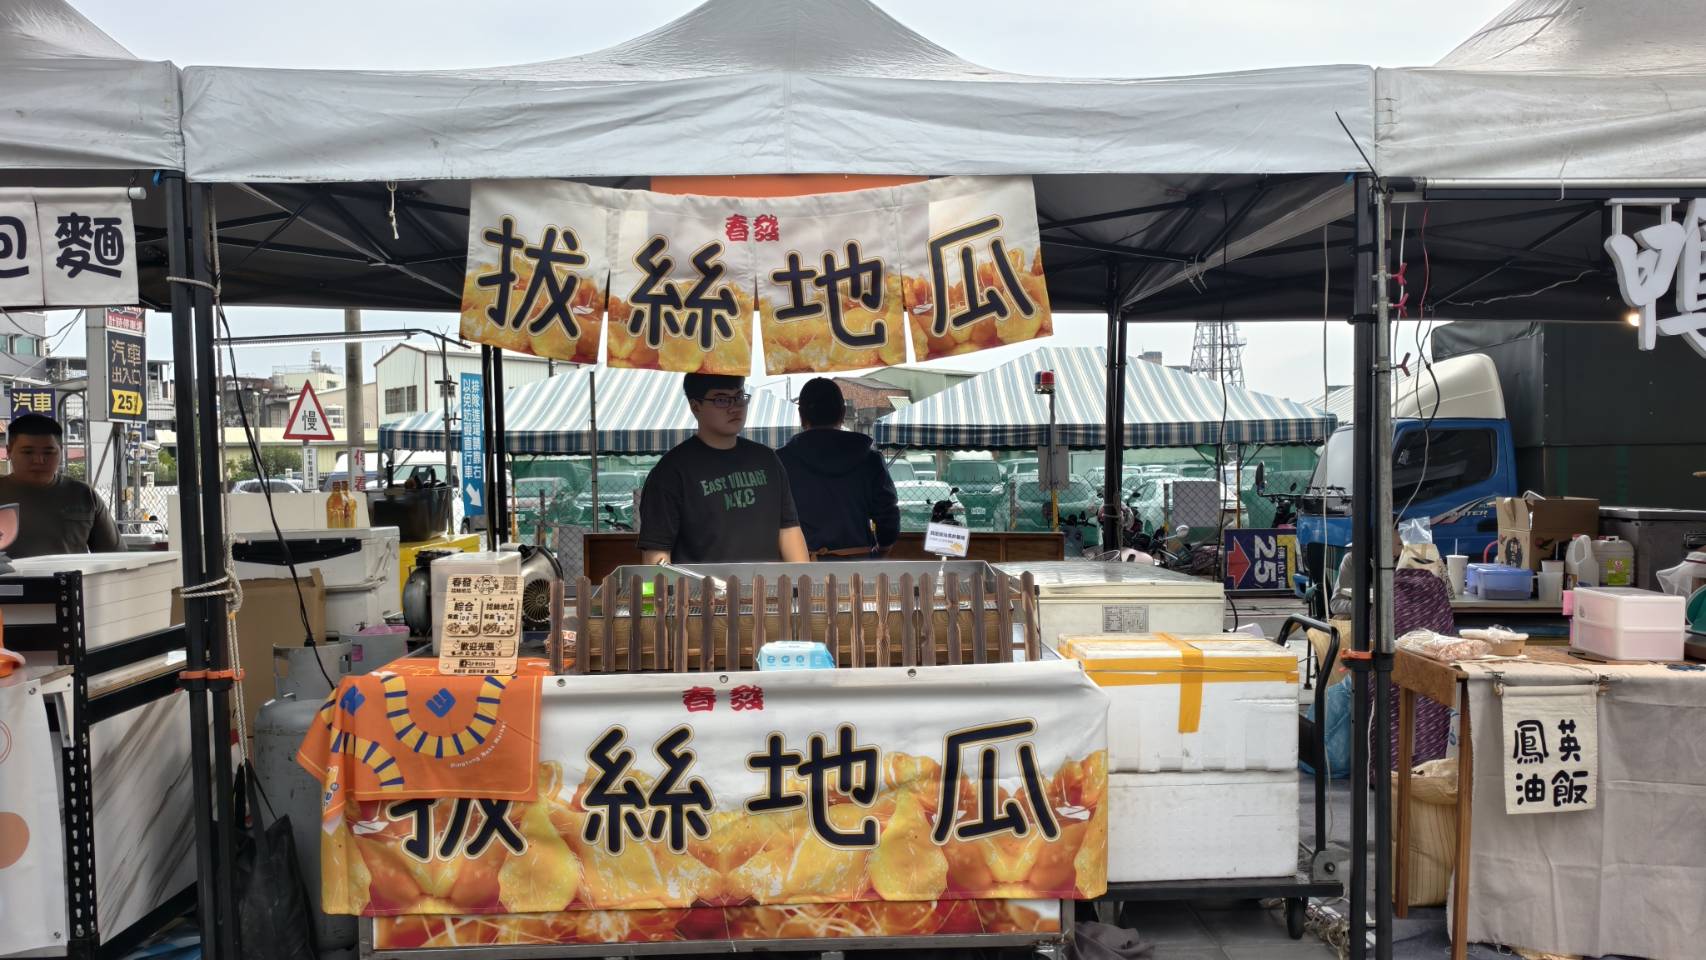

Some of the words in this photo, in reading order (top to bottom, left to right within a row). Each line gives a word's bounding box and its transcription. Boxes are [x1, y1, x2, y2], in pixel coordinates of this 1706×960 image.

[476, 212, 1035, 352] 拔絲地瓜
[111, 339, 141, 366] 汽車
[111, 366, 142, 386] 出入口
[13, 392, 53, 413] 汽車
[117, 394, 133, 411] 25
[302, 410, 317, 431] 慢
[700, 477, 728, 496] EAST
[1254, 534, 1277, 584] 25
[1515, 769, 1588, 807] 油飯
